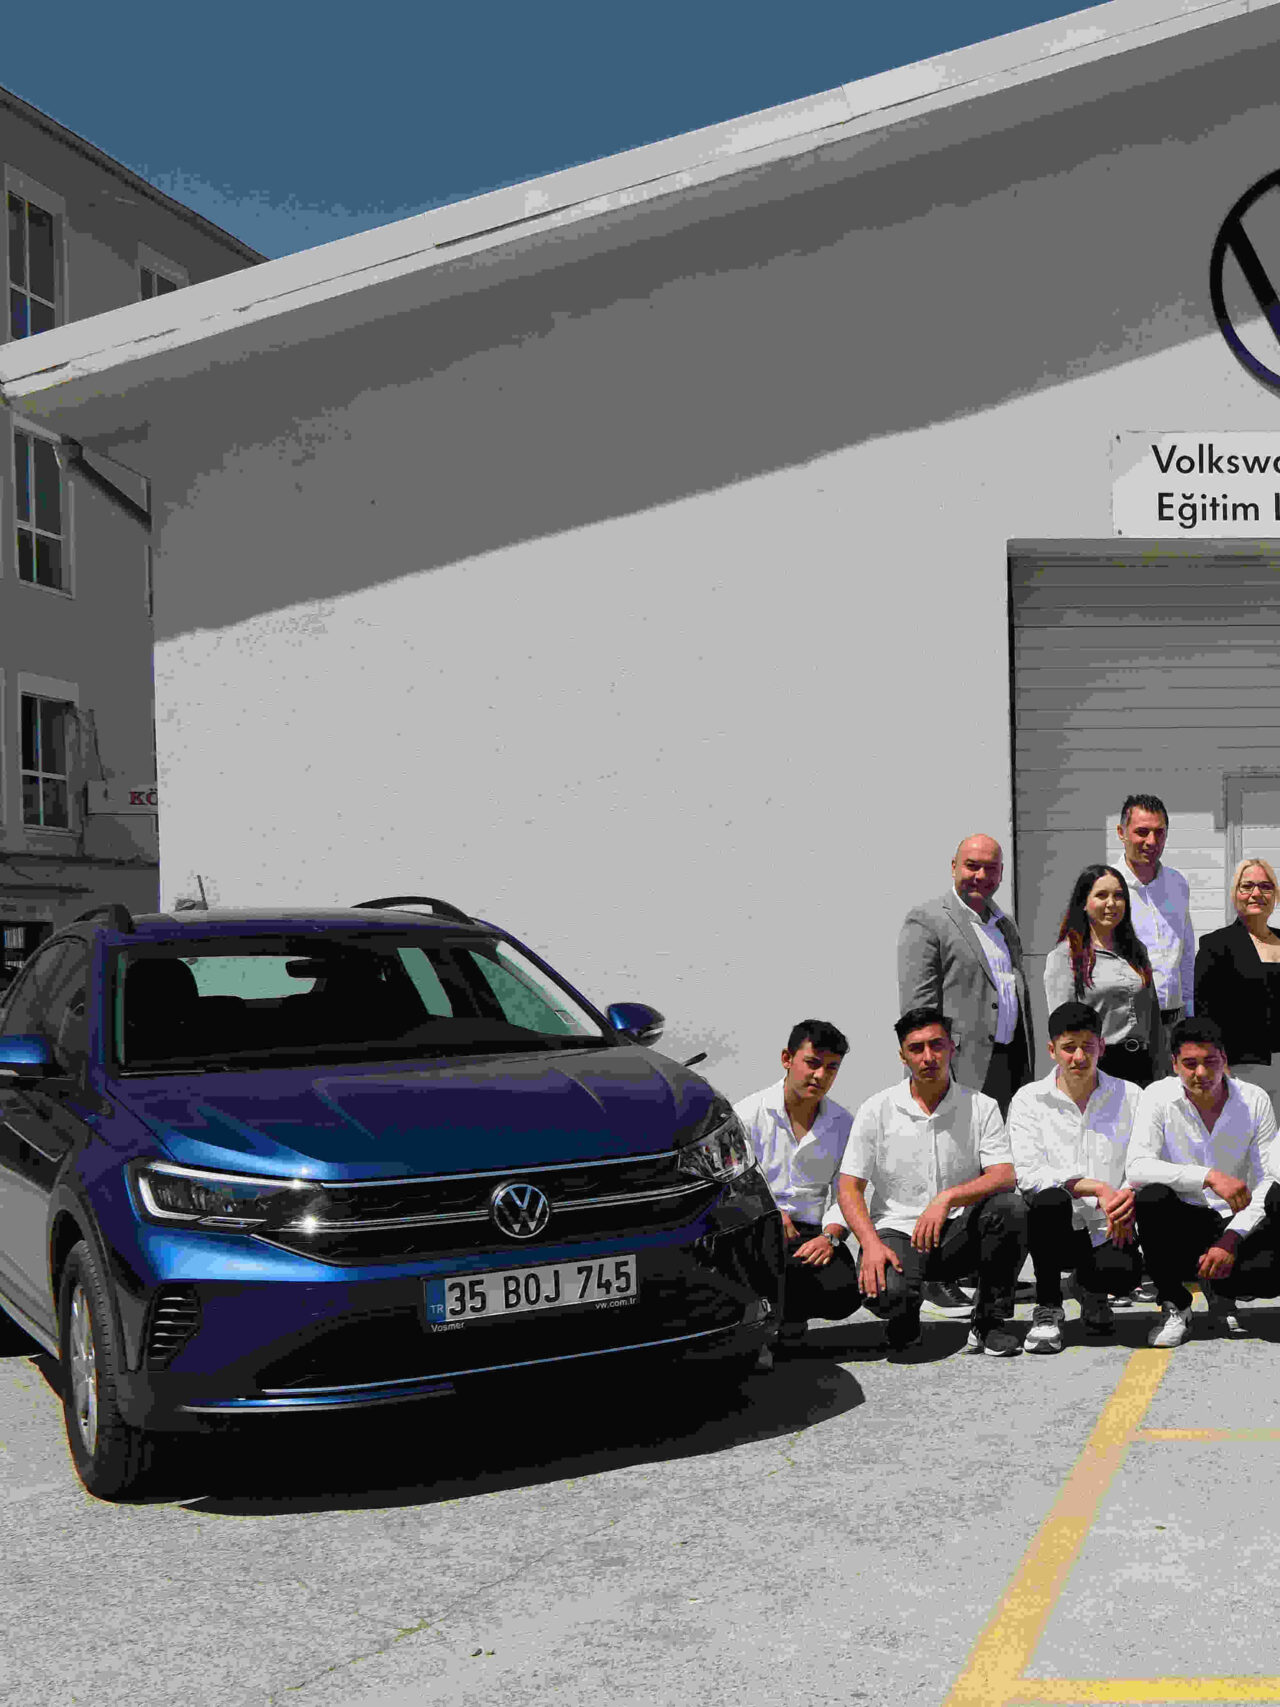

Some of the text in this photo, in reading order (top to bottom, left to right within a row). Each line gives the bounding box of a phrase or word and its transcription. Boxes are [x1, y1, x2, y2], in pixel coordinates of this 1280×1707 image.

[1157, 491, 1260, 529] Eğitim
[448, 1260, 632, 1316] 35 BOJ 745
[430, 1304, 444, 1315] TR
[594, 1296, 637, 1310] vw.com.tr
[431, 1321, 465, 1333] Vosmer
